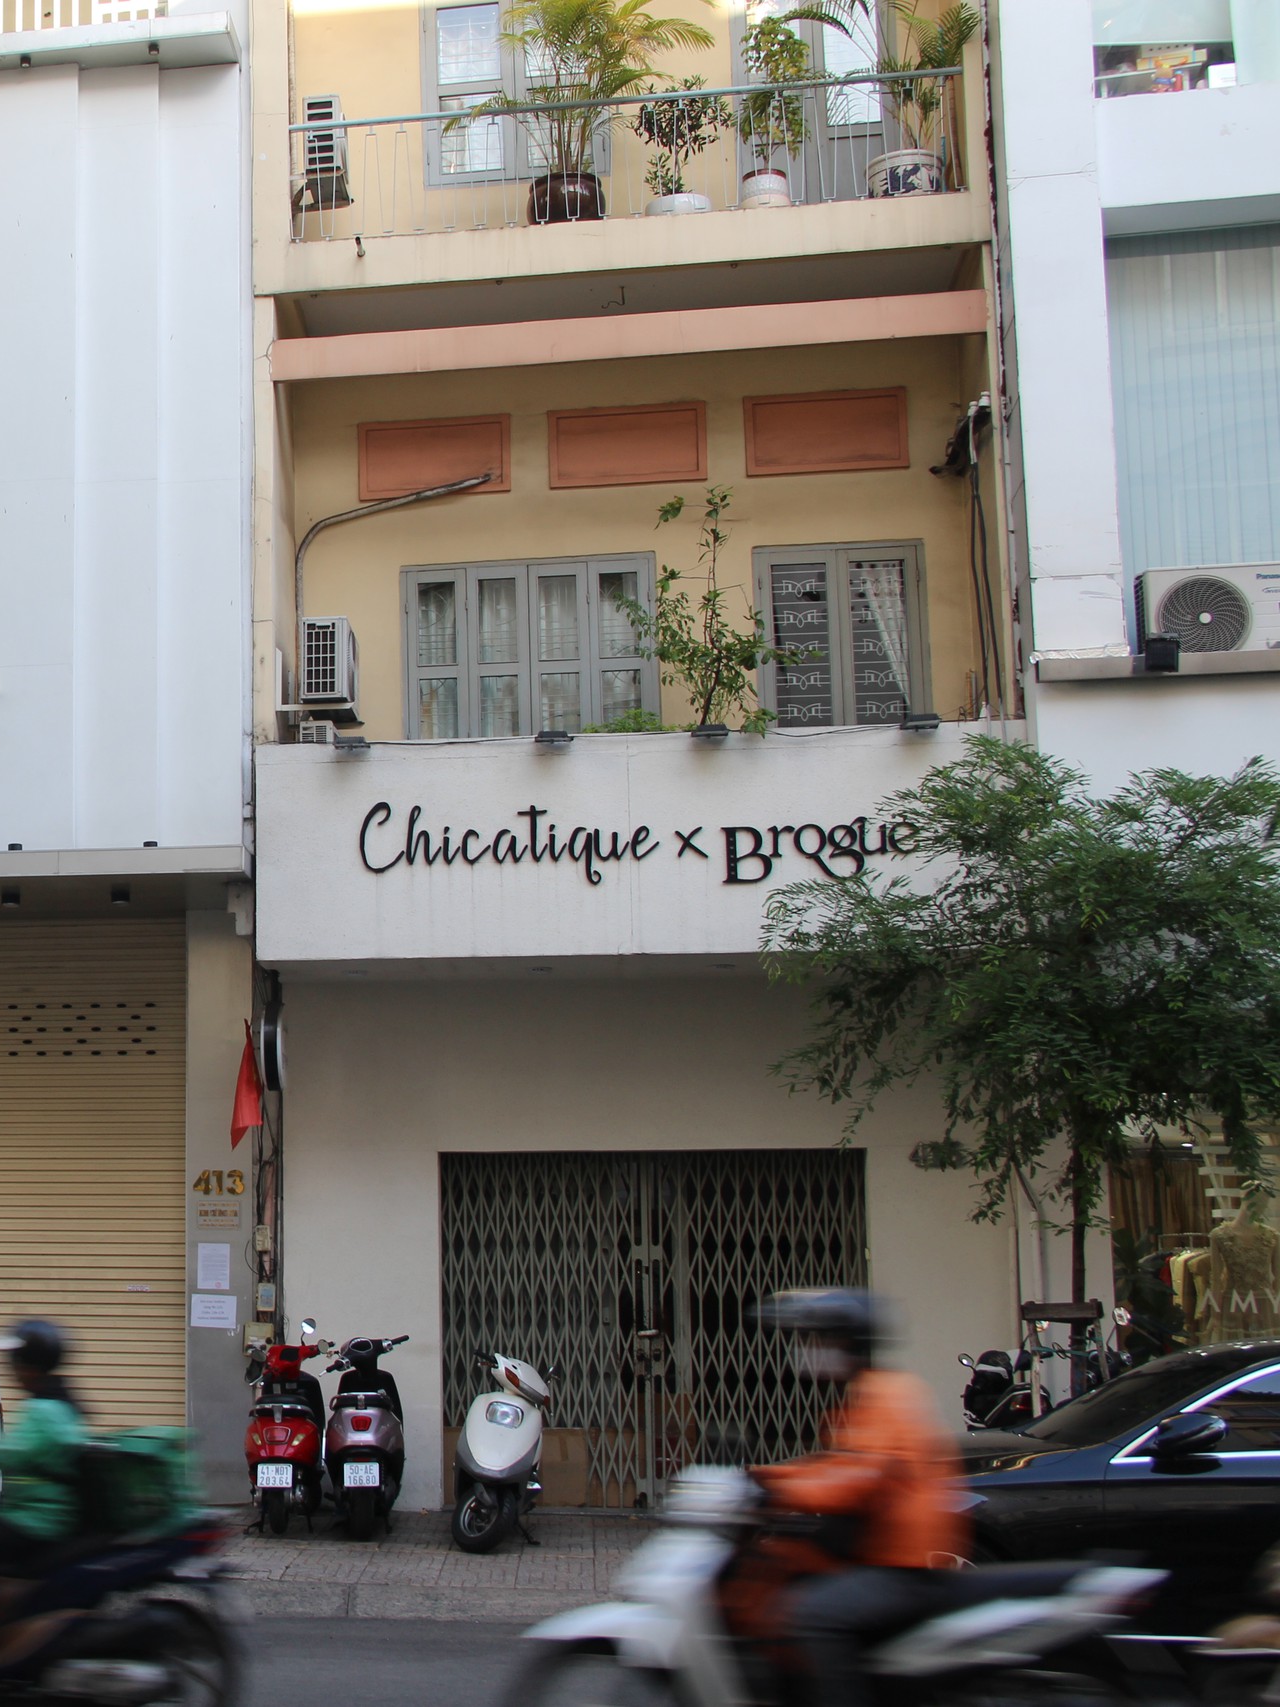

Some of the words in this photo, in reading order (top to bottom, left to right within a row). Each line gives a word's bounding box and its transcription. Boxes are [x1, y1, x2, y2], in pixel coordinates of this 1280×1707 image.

[360, 802, 660, 885] Chicatique
[721, 816, 920, 884] Brogue
[193, 1169, 245, 1195] 413
